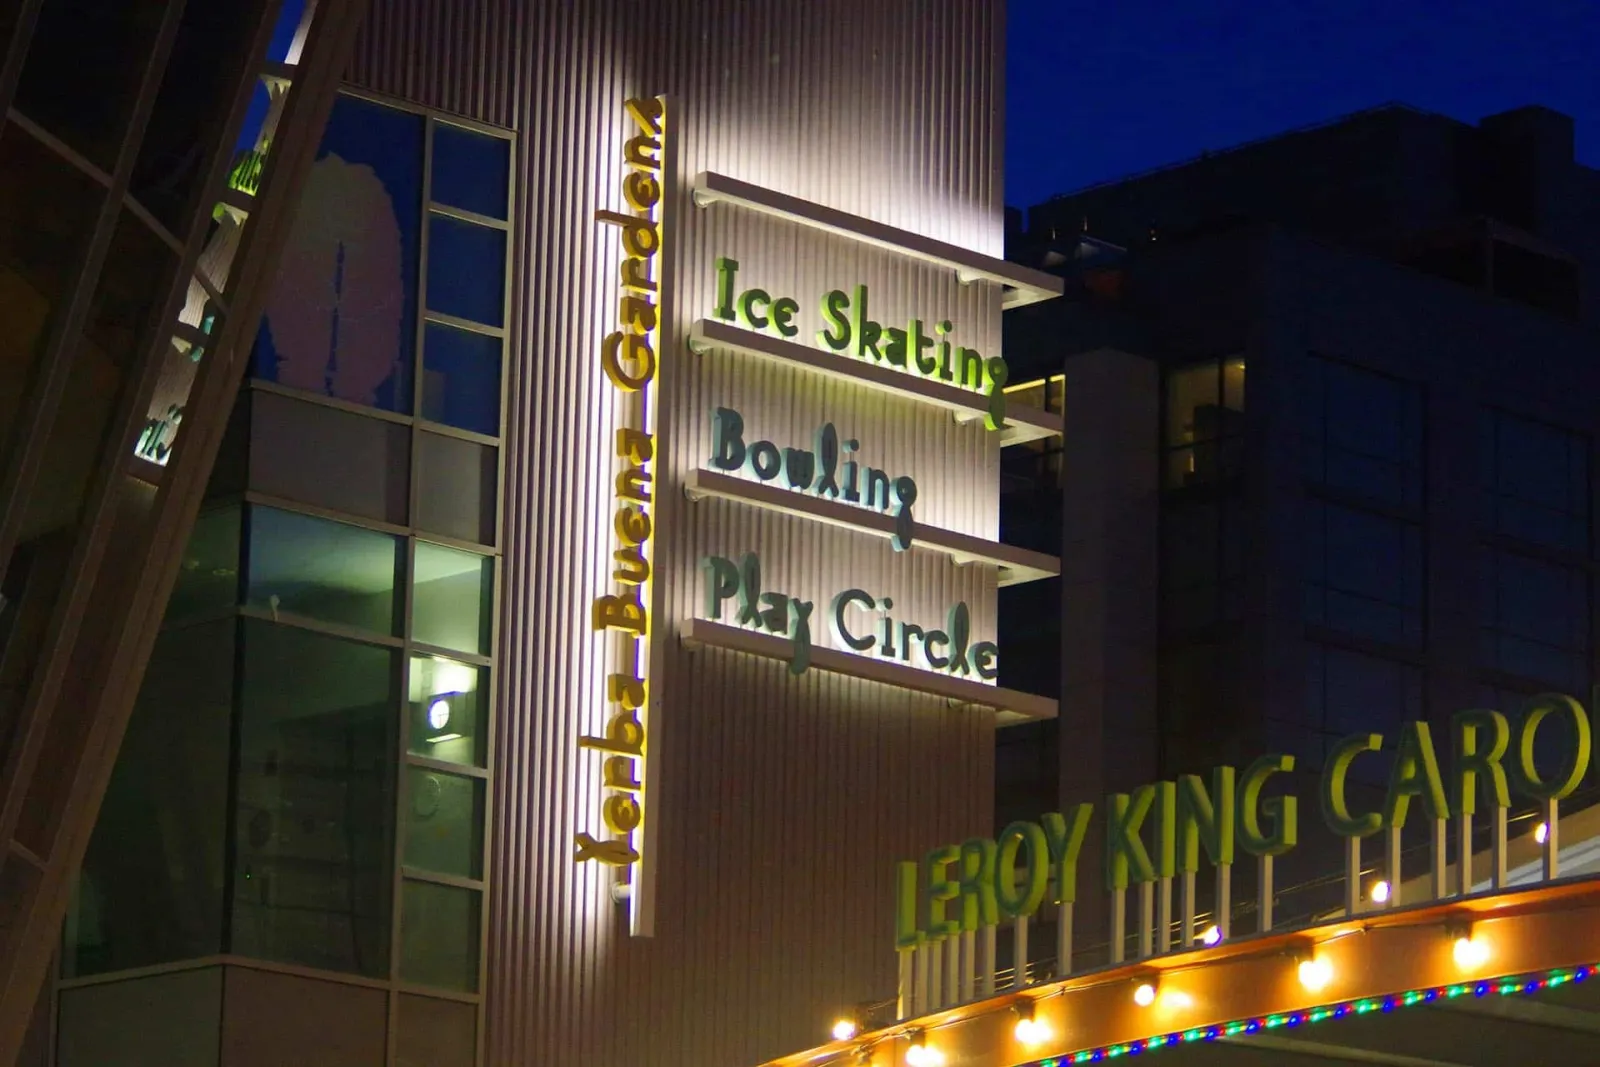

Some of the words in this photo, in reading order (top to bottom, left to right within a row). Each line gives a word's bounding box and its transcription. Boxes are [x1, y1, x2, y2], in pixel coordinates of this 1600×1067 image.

[595, 97, 663, 393] Gardens
[712, 256, 799, 337] Ice
[816, 284, 1008, 431] Skating
[592, 428, 654, 638] Buena
[707, 406, 918, 552] Bowling
[702, 551, 813, 675] Play
[829, 588, 999, 680] Circle
[573, 673, 645, 867] Yerba
[895, 803, 1094, 952] LEROY
[1107, 755, 1297, 892] KING
[1321, 685, 1600, 839] CARO
